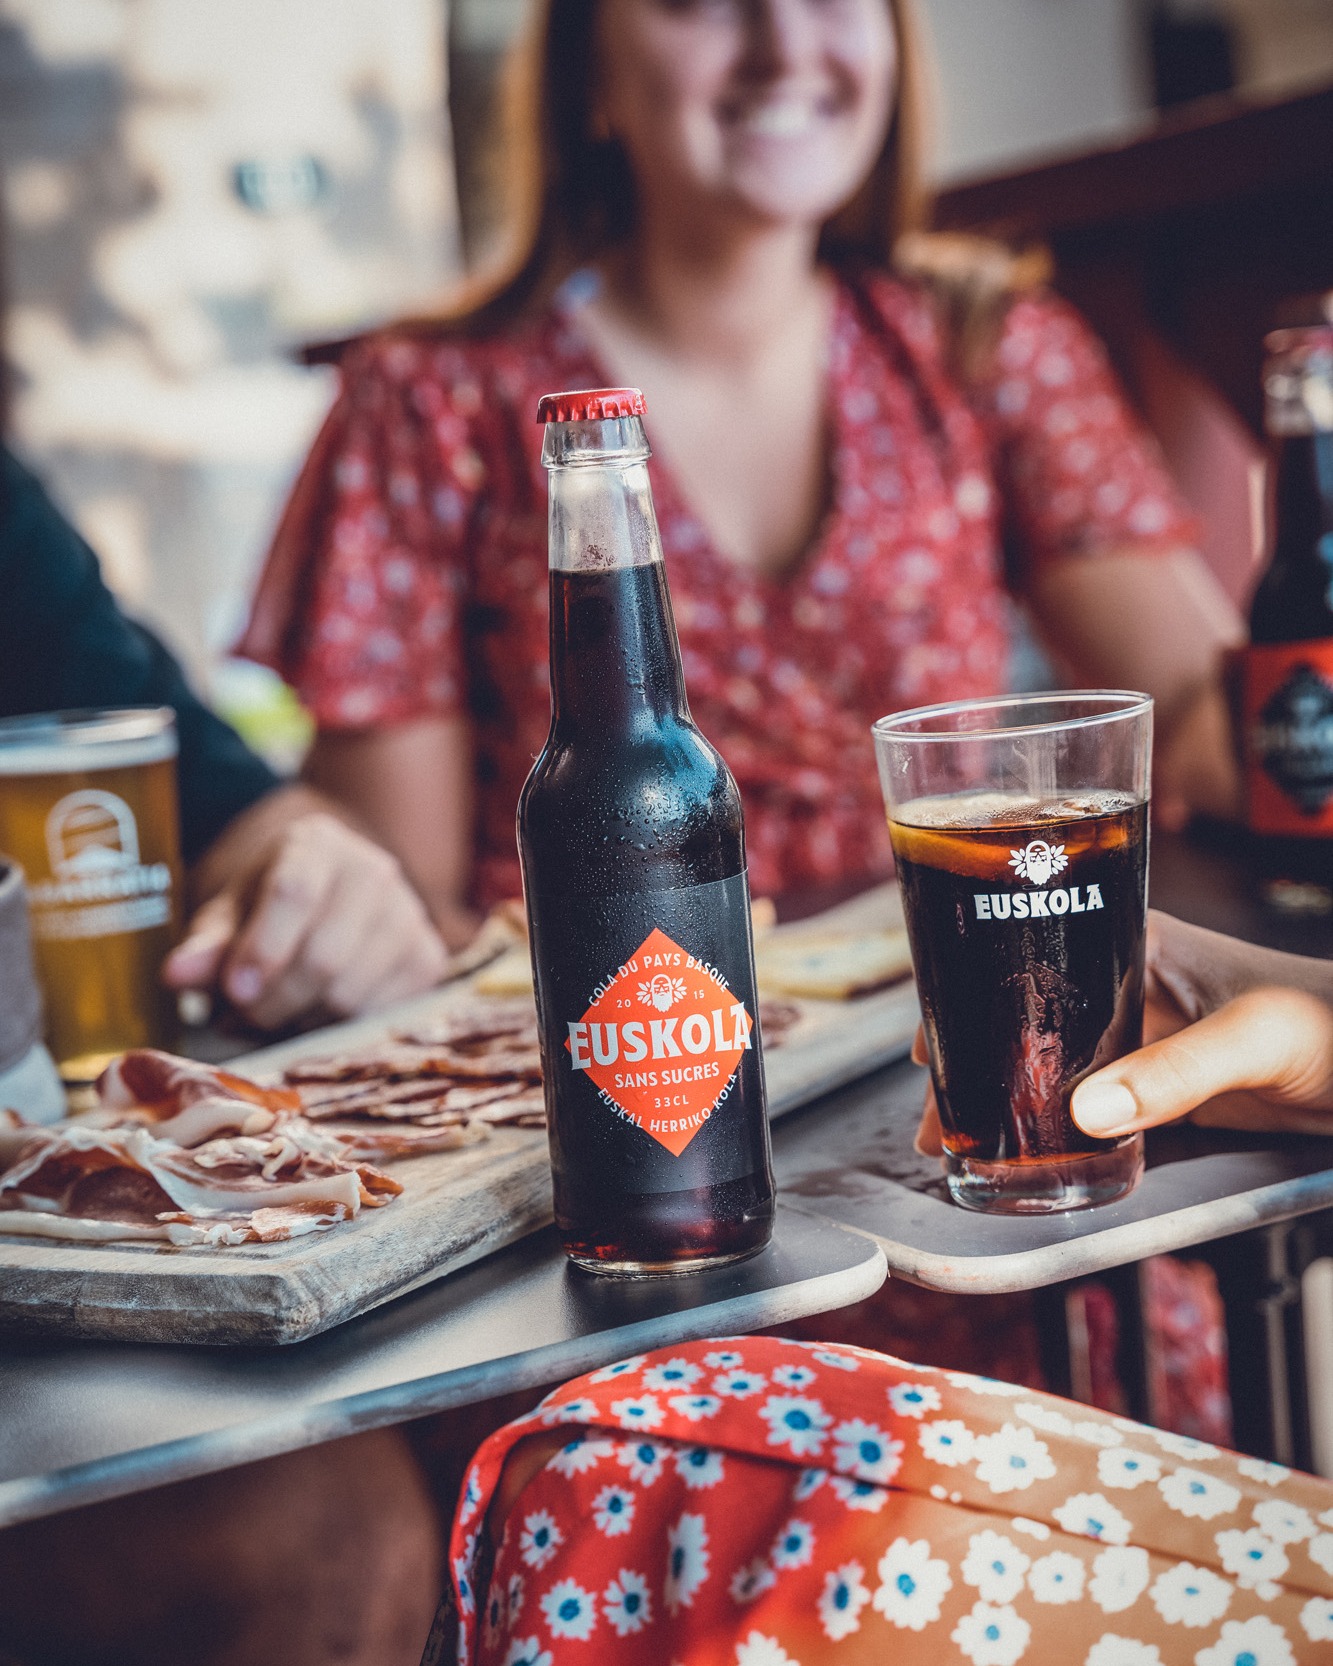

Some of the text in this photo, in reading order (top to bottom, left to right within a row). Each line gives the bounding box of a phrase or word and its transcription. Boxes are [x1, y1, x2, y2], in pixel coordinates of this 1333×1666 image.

[973, 883, 1105, 920] EUSKOLA
[588, 953, 730, 1007] COLA DU PAYS BASQUE
[616, 989, 705, 1009] 20 15
[567, 1001, 753, 1071] EUSKOLA
[614, 1061, 720, 1089] SANS SUCRES
[597, 1073, 738, 1133] EUSKAL HERRIKO KOLA
[654, 1095, 690, 1109] 33CL
